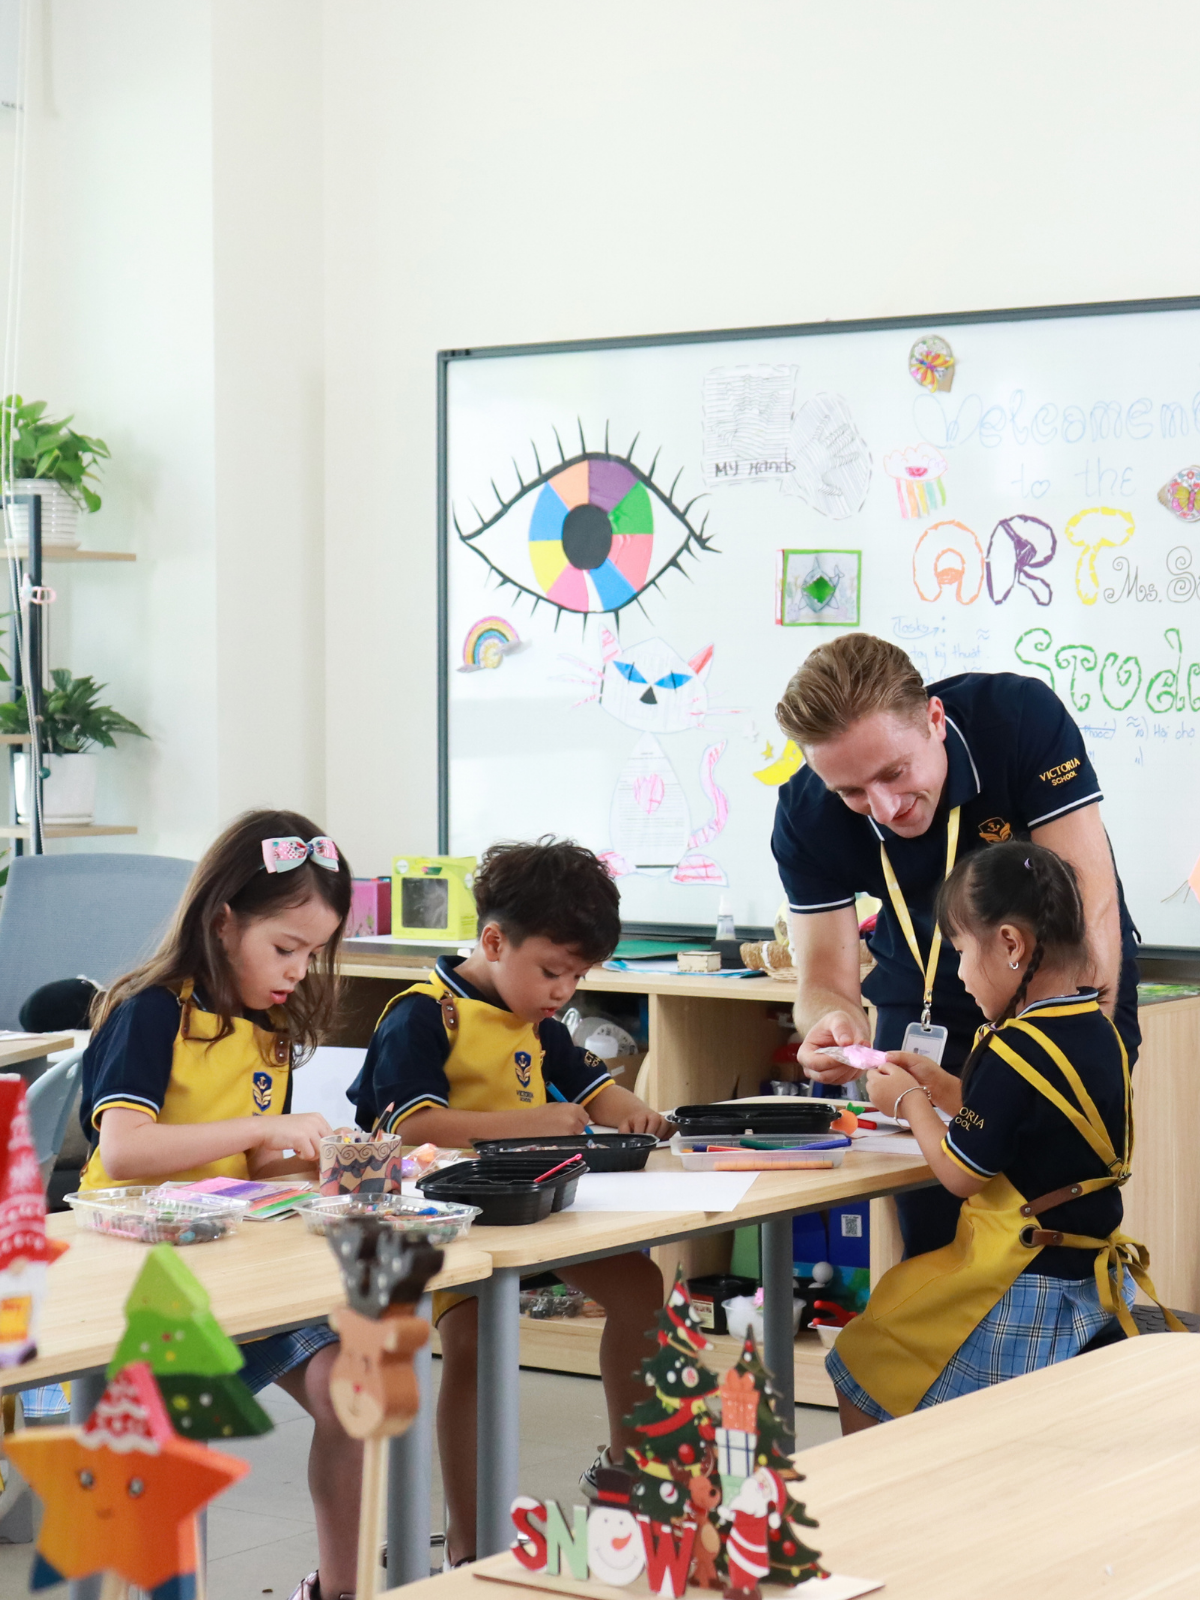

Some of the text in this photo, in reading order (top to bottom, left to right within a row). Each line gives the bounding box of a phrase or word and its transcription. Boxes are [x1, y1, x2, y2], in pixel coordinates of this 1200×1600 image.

[1011, 456, 1138, 500] to the
[913, 505, 1136, 606] ART
[1039, 757, 1081, 782] VICTORIA
[1051, 770, 1078, 787] SCHOOL
